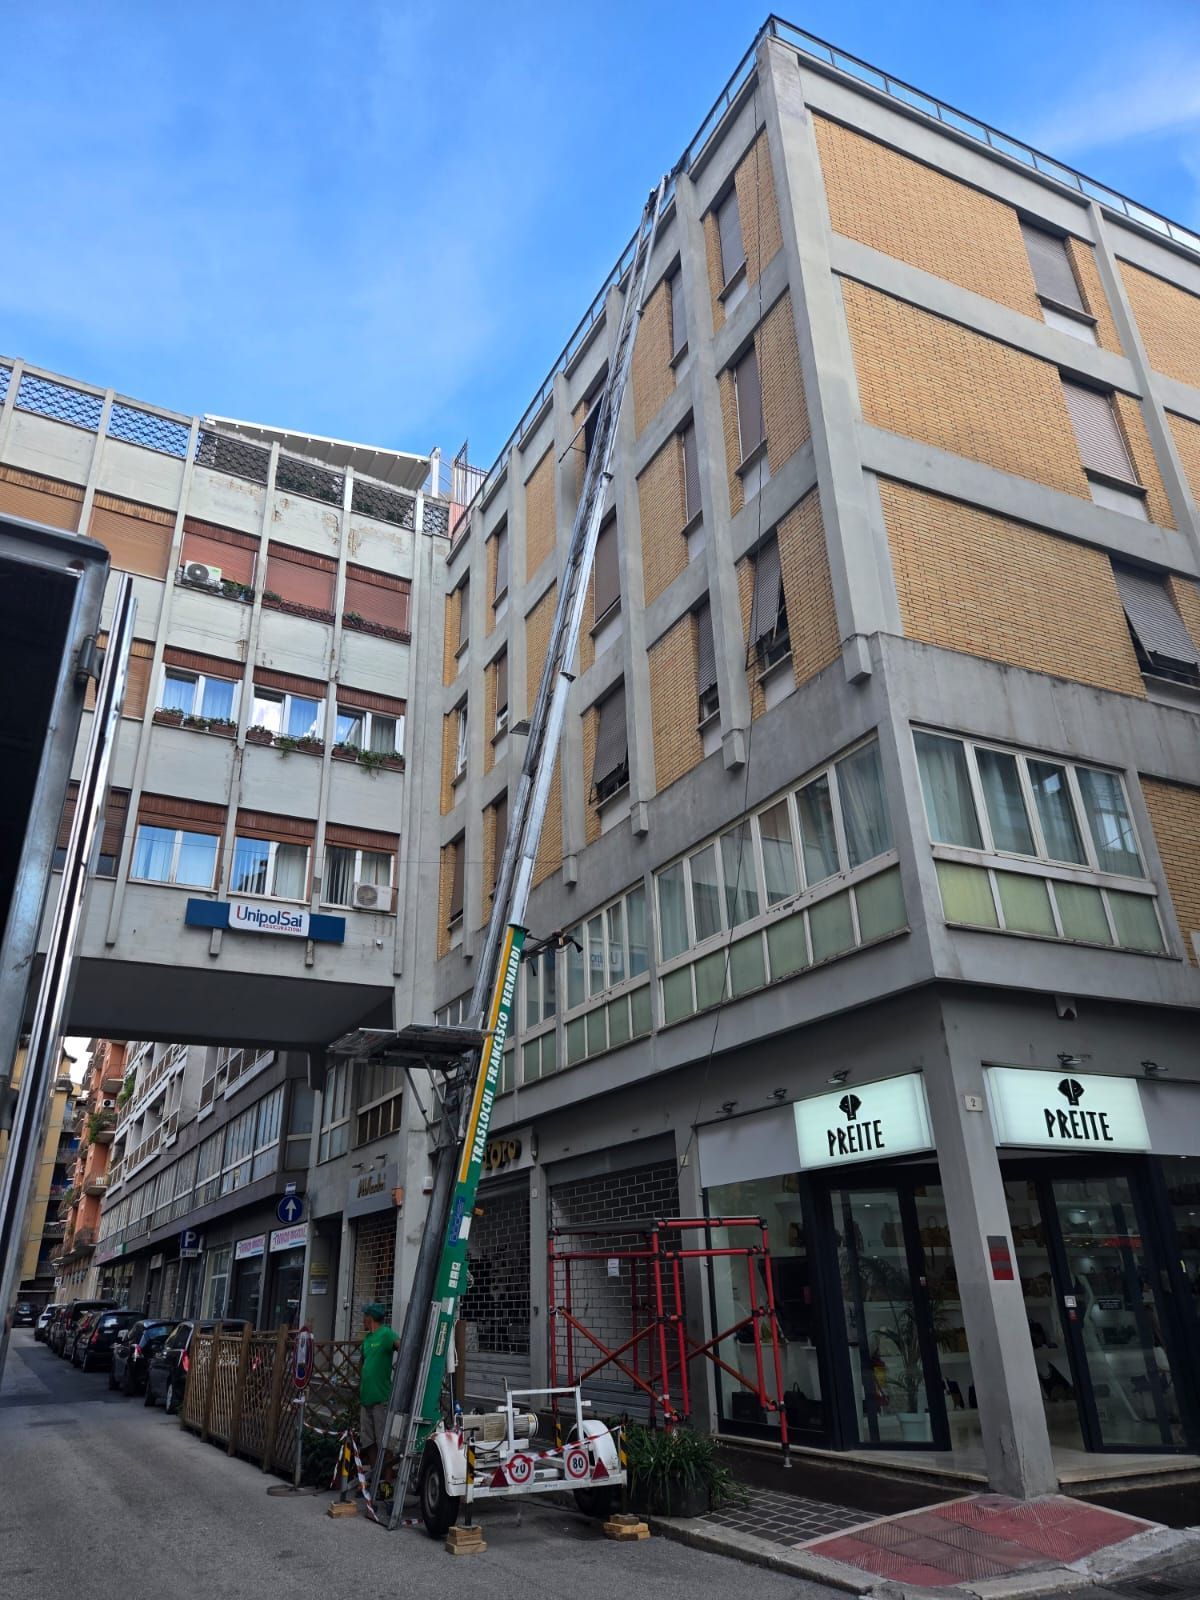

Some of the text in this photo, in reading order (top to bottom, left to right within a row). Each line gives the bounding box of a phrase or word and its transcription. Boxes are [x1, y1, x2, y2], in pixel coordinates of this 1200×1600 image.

[236, 905, 302, 928] UnipolSai
[472, 945, 521, 1164] TRASLOCHI FRANCESCO BERNARDI
[827, 1119, 886, 1157] PREITE
[1043, 1108, 1114, 1142] PREITE
[184, 1231, 197, 1247] P
[573, 1457, 584, 1470] 80
